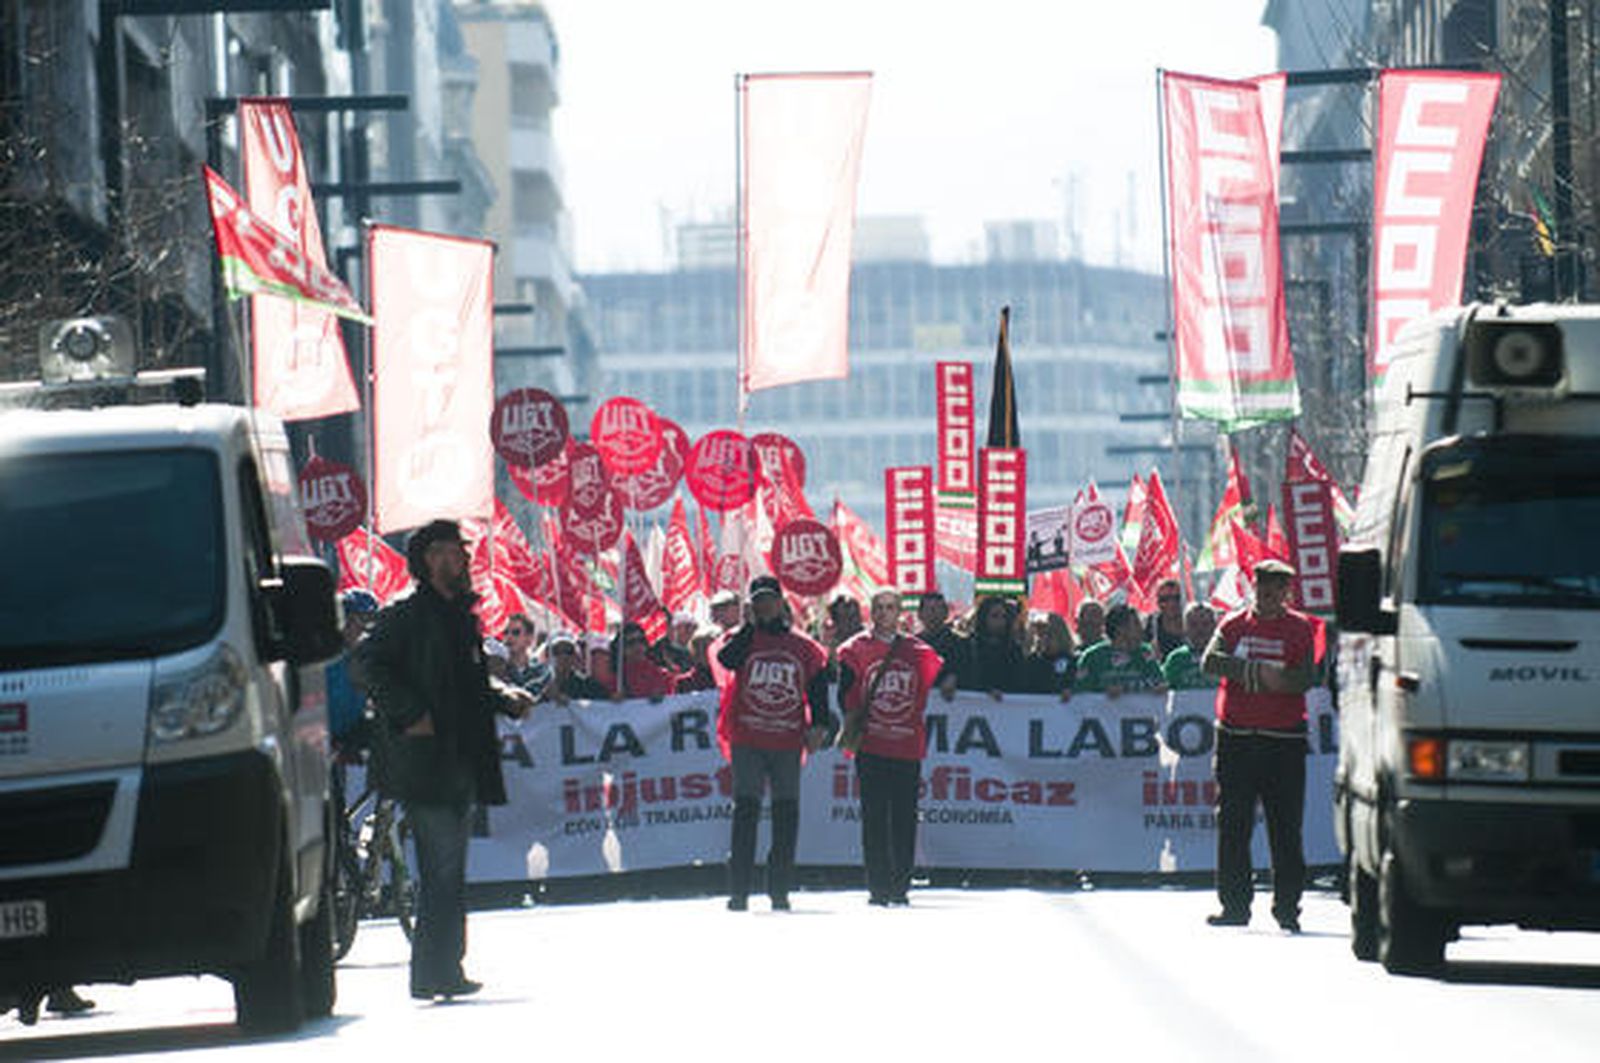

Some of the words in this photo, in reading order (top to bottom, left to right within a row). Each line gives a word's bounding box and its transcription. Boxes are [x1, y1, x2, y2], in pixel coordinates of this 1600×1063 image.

[502, 400, 553, 434] UGT
[602, 404, 649, 435] UGT
[943, 364, 970, 490] CCOO
[698, 436, 750, 470] UGT
[302, 473, 352, 505] UGT
[895, 469, 926, 591] CCOO
[985, 450, 1017, 576] CCOO
[781, 533, 829, 563] UGT
[1290, 483, 1334, 607] CCOO
[750, 660, 798, 686] UGT
[560, 723, 645, 765] LA
[1144, 813, 1194, 830] PARA
